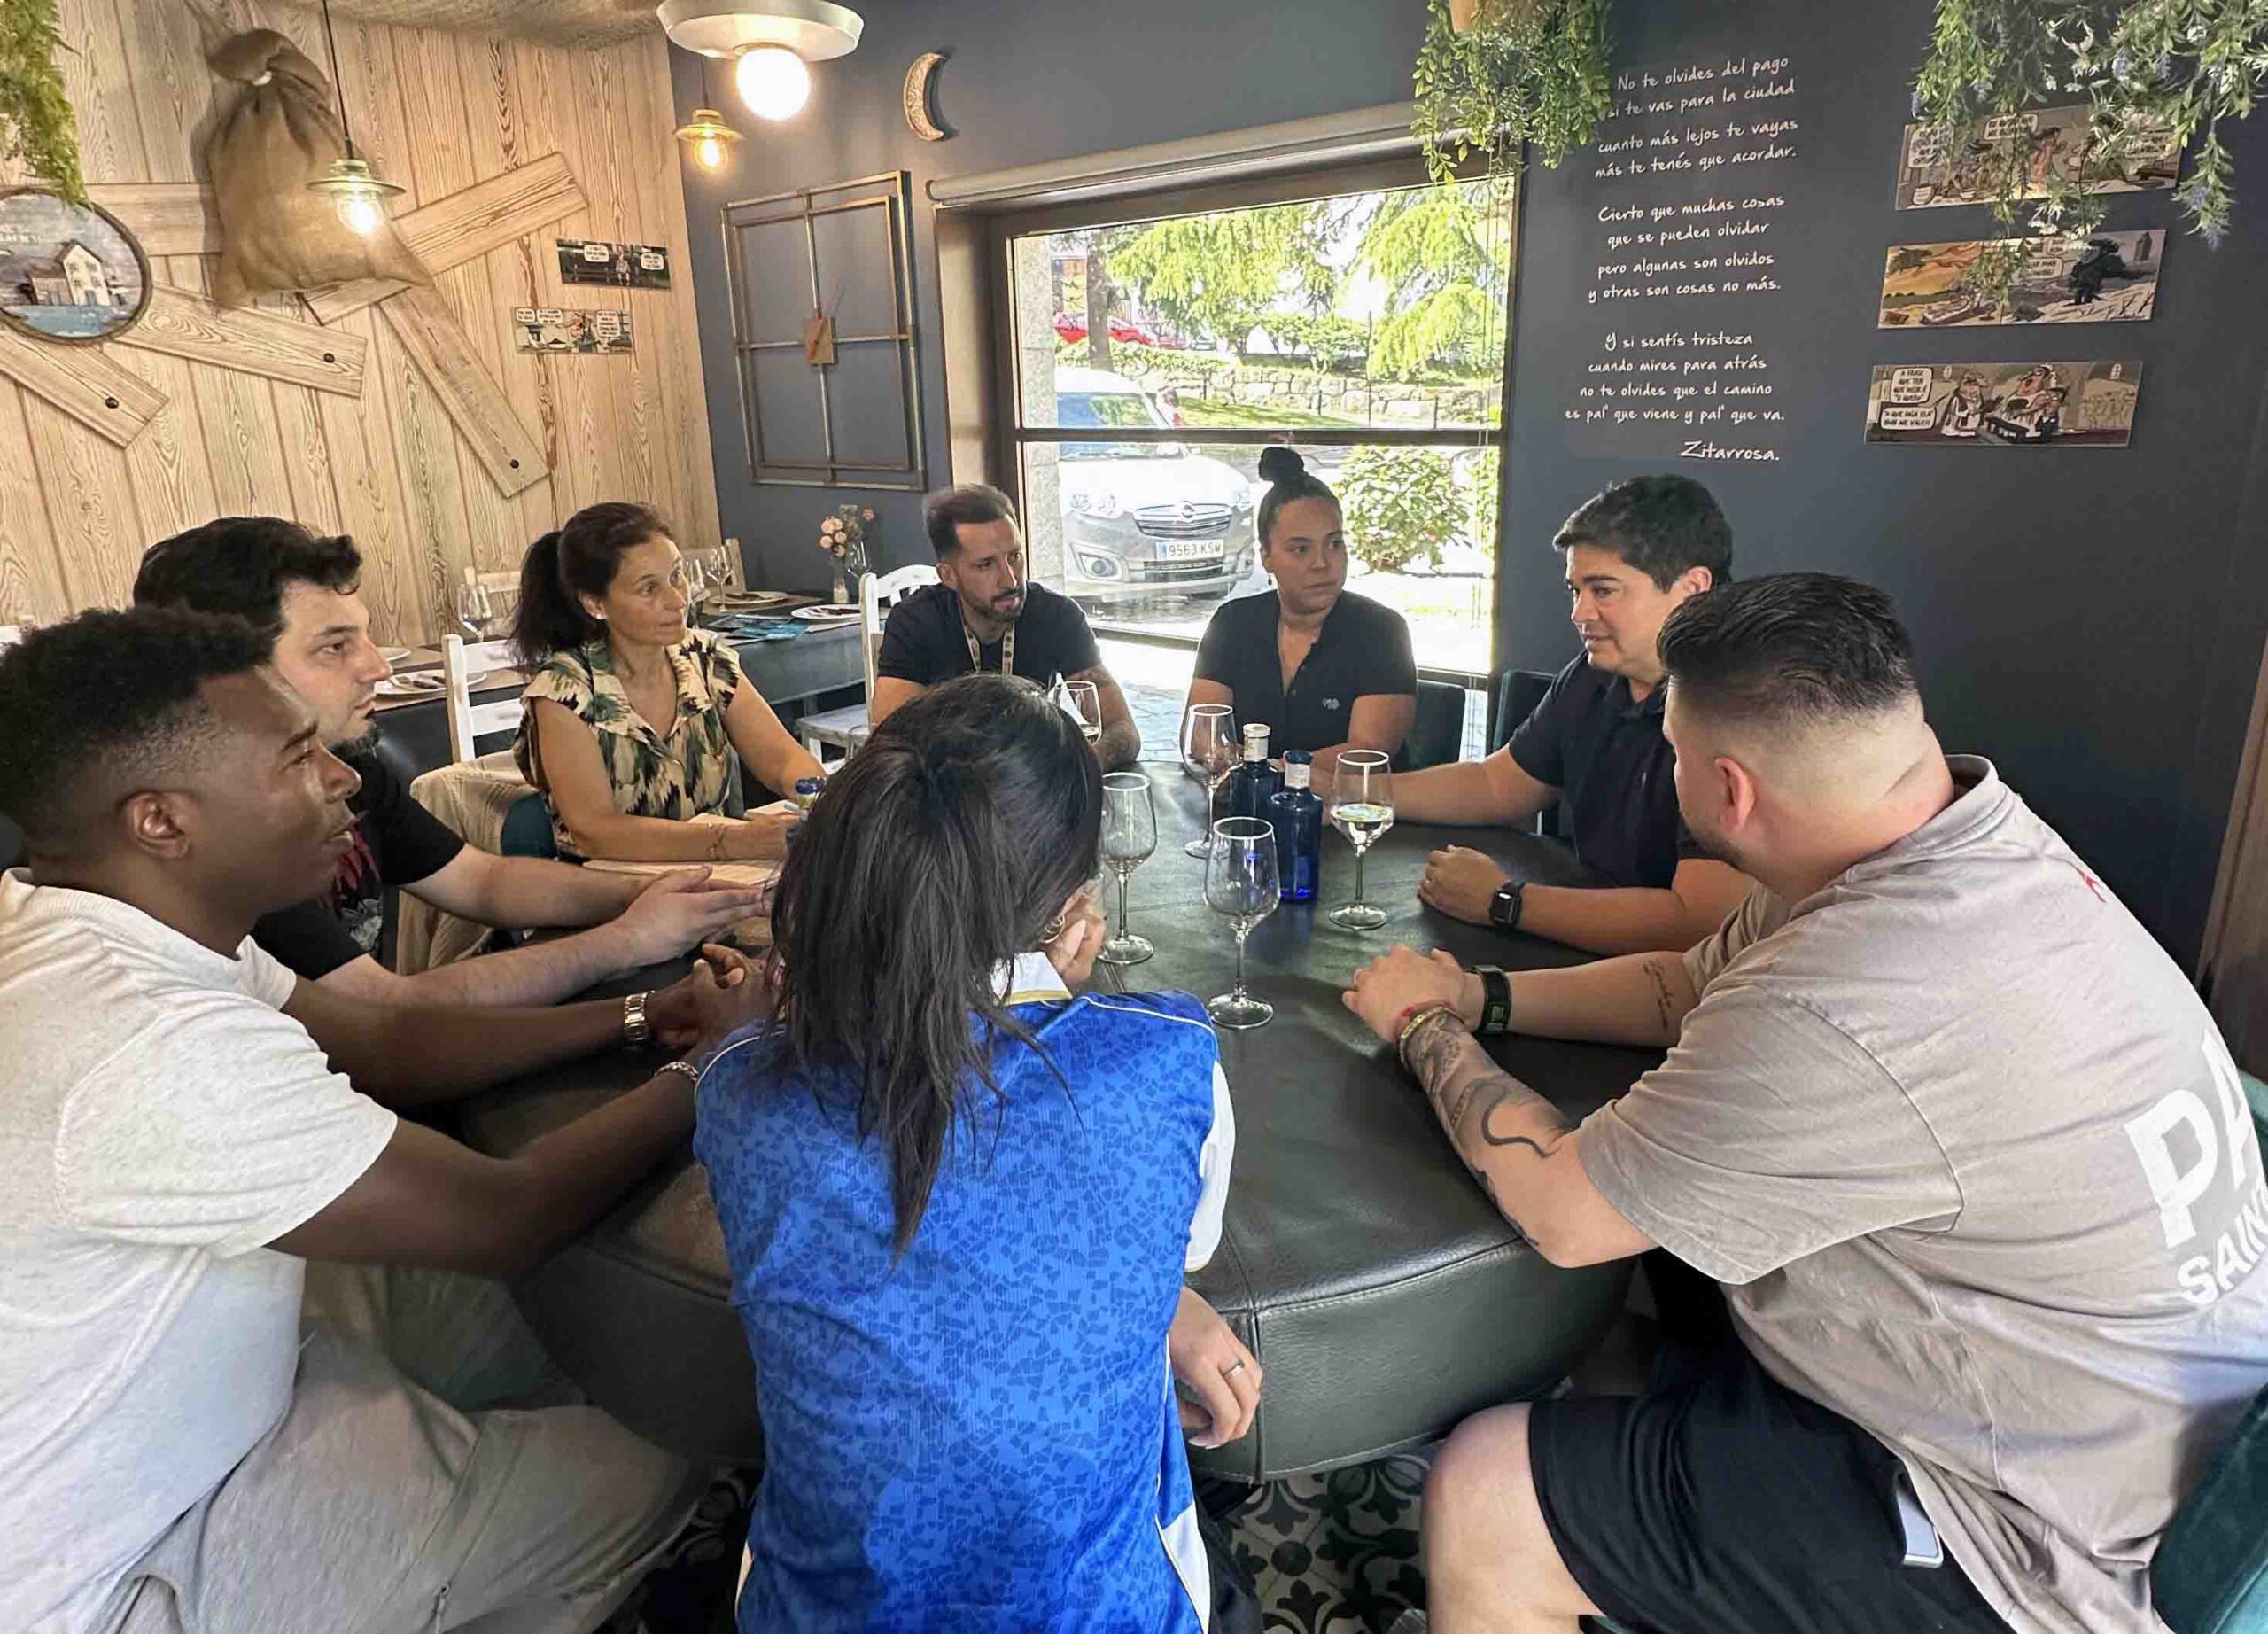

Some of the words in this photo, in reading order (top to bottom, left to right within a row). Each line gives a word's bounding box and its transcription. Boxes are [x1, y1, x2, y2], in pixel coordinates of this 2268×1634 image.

[1618, 74, 1635, 90] No
[1642, 72, 1659, 88] te
[1664, 66, 1714, 85] olvides
[1721, 57, 1746, 77] del
[1751, 56, 1789, 78] pago
[1625, 101, 1643, 115] te
[1648, 101, 1674, 113] vas
[1680, 95, 1715, 114] para
[1722, 87, 1736, 103] la
[1743, 78, 1795, 100] ciudad
[1597, 136, 1643, 153] cuanto
[1650, 129, 1679, 147] más
[1686, 127, 1720, 147] lejos
[1726, 121, 1745, 137] te
[1751, 120, 1798, 138] vayas
[1595, 161, 1623, 178] más
[1628, 159, 1646, 175] te
[1651, 151, 1692, 173] tenés
[1698, 155, 1726, 172] que
[1731, 143, 1797, 164] acordar.
[1597, 204, 1644, 222] Cierto
[1650, 206, 1676, 223] que
[1682, 197, 1735, 214] muchas
[1742, 196, 1785, 209] cosas
[1607, 235, 1633, 251] que
[1637, 233, 1655, 244] se
[1659, 223, 1710, 247] pueden
[1717, 219, 1770, 237] olvidar
[1597, 264, 1627, 280] pero
[1632, 257, 1687, 277] algunas
[1693, 257, 1718, 269] son
[1724, 250, 1775, 267] olvidos
[1603, 284, 1640, 299] otras
[1646, 284, 1669, 297] son
[1675, 284, 1716, 295] cosas
[1722, 281, 1740, 292] no
[1745, 275, 1781, 292] más.
[1640, 331, 1686, 348] sentís
[1691, 331, 1753, 346] tristeza
[1588, 357, 1634, 373] cuando
[1639, 359, 1677, 371] mires
[1683, 361, 1717, 376] para
[1723, 354, 1767, 370] atrás
[1580, 386, 1595, 397] no
[1599, 383, 1616, 397] te
[1620, 382, 1666, 397] olvides
[1673, 386, 1698, 401] que
[1704, 380, 1717, 395] el
[1723, 385, 1773, 395] camino
[1565, 409, 1581, 419] es
[1613, 409, 1638, 424] que
[1643, 409, 1680, 420] viene
[1730, 410, 1758, 425] que
[1762, 410, 1785, 421] va.
[1680, 440, 1780, 462] Zitarrosa.
[1169, 544, 1197, 556] 9563
